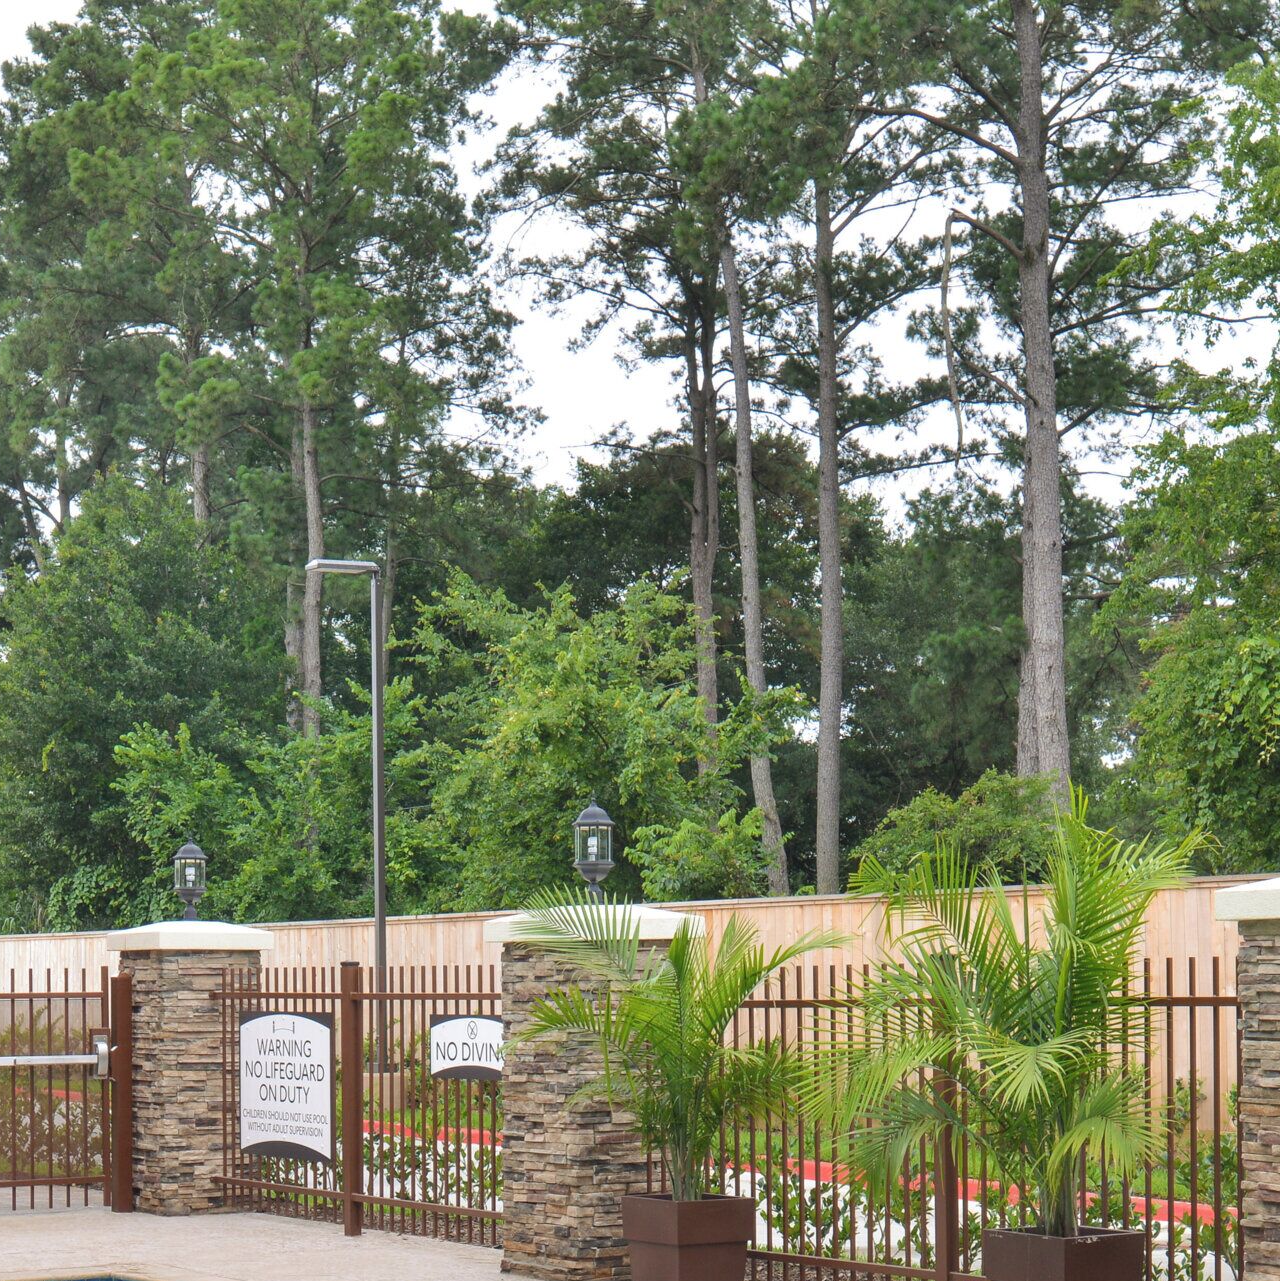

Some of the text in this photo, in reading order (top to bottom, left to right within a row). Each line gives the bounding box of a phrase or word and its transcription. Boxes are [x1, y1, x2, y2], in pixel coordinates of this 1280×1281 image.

[256, 1038, 312, 1058] WARNING
[436, 1041, 505, 1063] NO DIVIN
[245, 1060, 325, 1082] NO LIFEGUARD
[259, 1083, 310, 1104] ON DUTY
[243, 1108, 328, 1125] CHILDREN SHOULD NOT USE POOL
[248, 1121, 324, 1137] WITHOUT ADULT SUPERVISION
